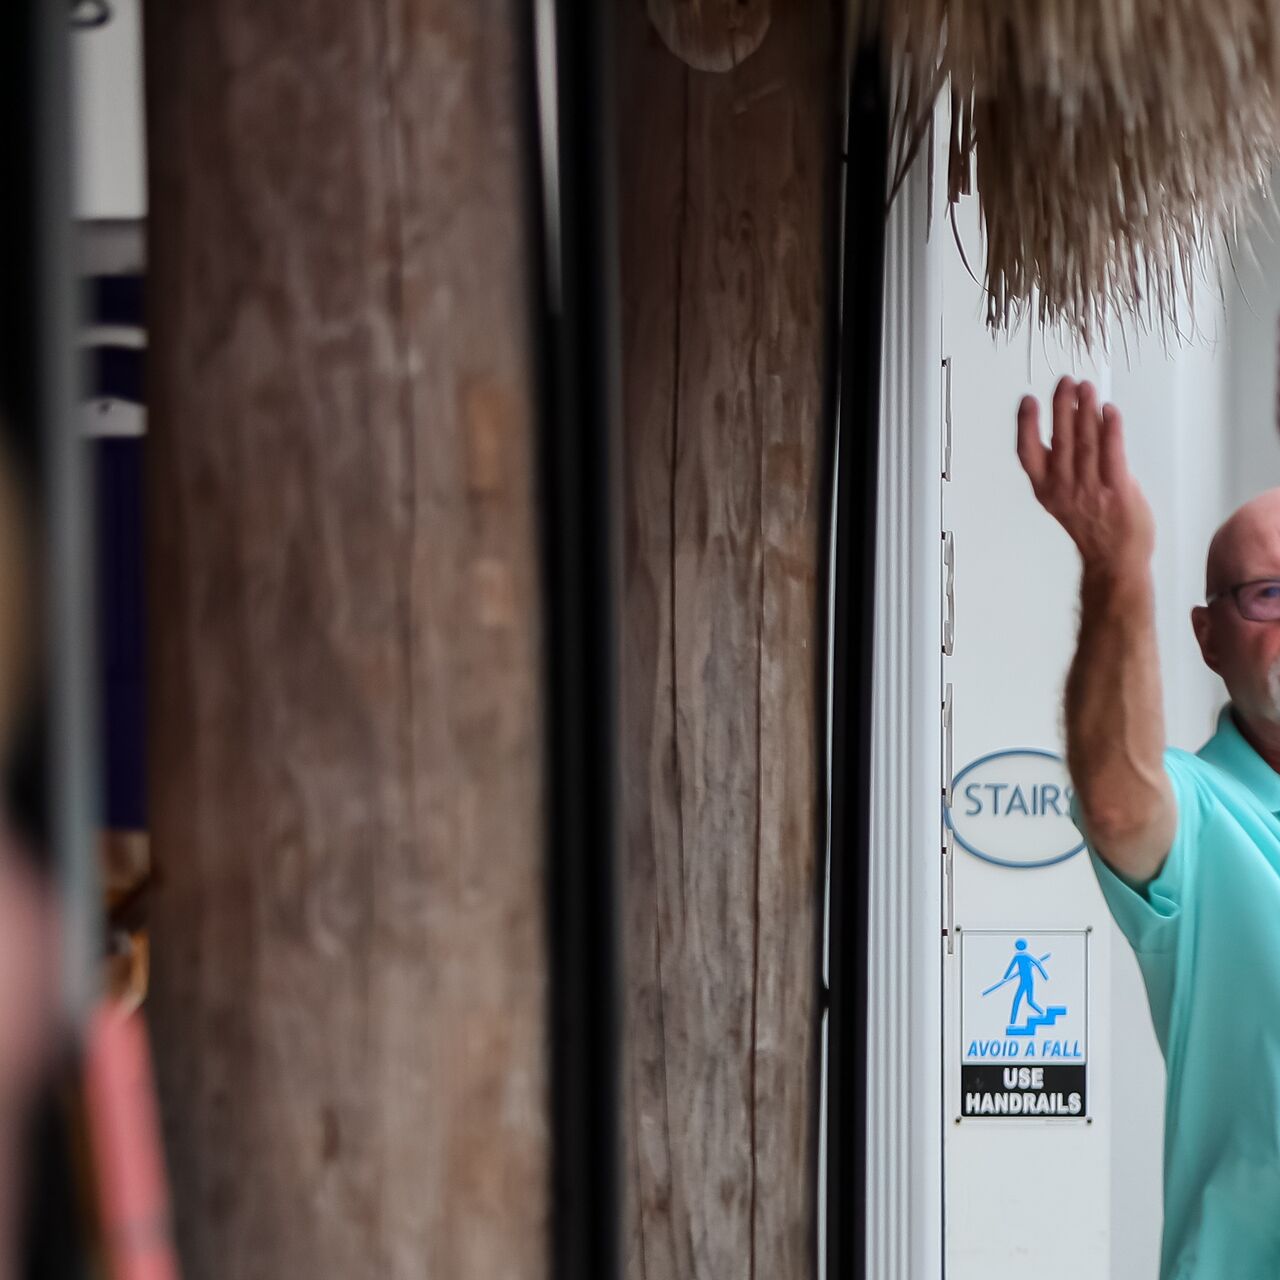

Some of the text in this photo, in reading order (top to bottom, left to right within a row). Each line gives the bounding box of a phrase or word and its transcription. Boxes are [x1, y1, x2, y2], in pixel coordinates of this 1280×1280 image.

[967, 1039, 1082, 1057] AVOID A FALL
[1003, 1067, 1044, 1090] USE
[966, 1092, 1082, 1115] HANDRAILS
